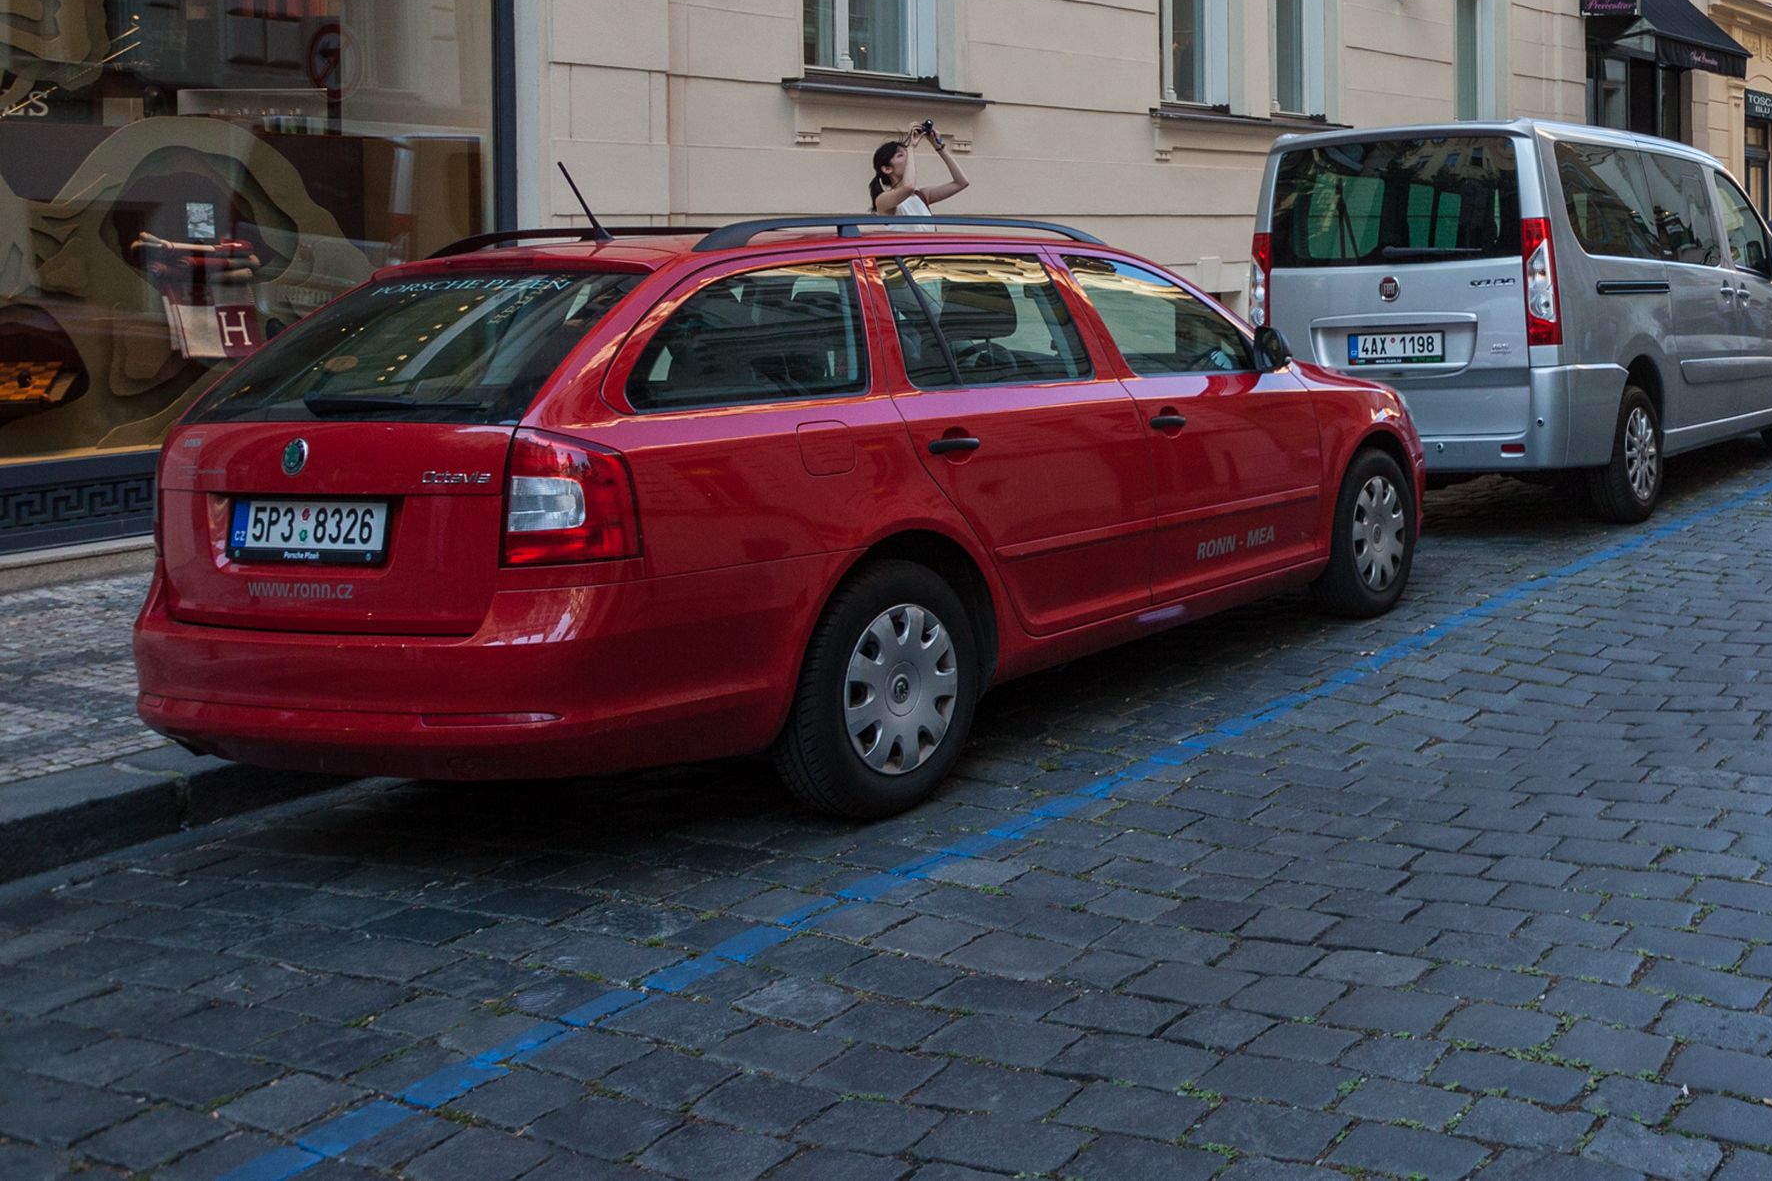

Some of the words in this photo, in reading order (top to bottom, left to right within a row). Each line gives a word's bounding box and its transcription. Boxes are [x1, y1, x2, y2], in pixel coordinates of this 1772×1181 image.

[1755, 106, 1770, 114] BLU
[371, 278, 483, 297] PORSCHE
[218, 311, 252, 346] H
[1361, 335, 1388, 356] 4AX
[1400, 335, 1435, 354] 1198
[422, 470, 491, 483] Octavia
[234, 530, 246, 541] CZ
[252, 506, 296, 543] 5P3
[313, 507, 374, 545] 8326
[1197, 534, 1237, 561] RONN
[1246, 525, 1276, 548] MEA
[283, 550, 304, 560] Porsche
[248, 582, 353, 599] www.ronn.cz
